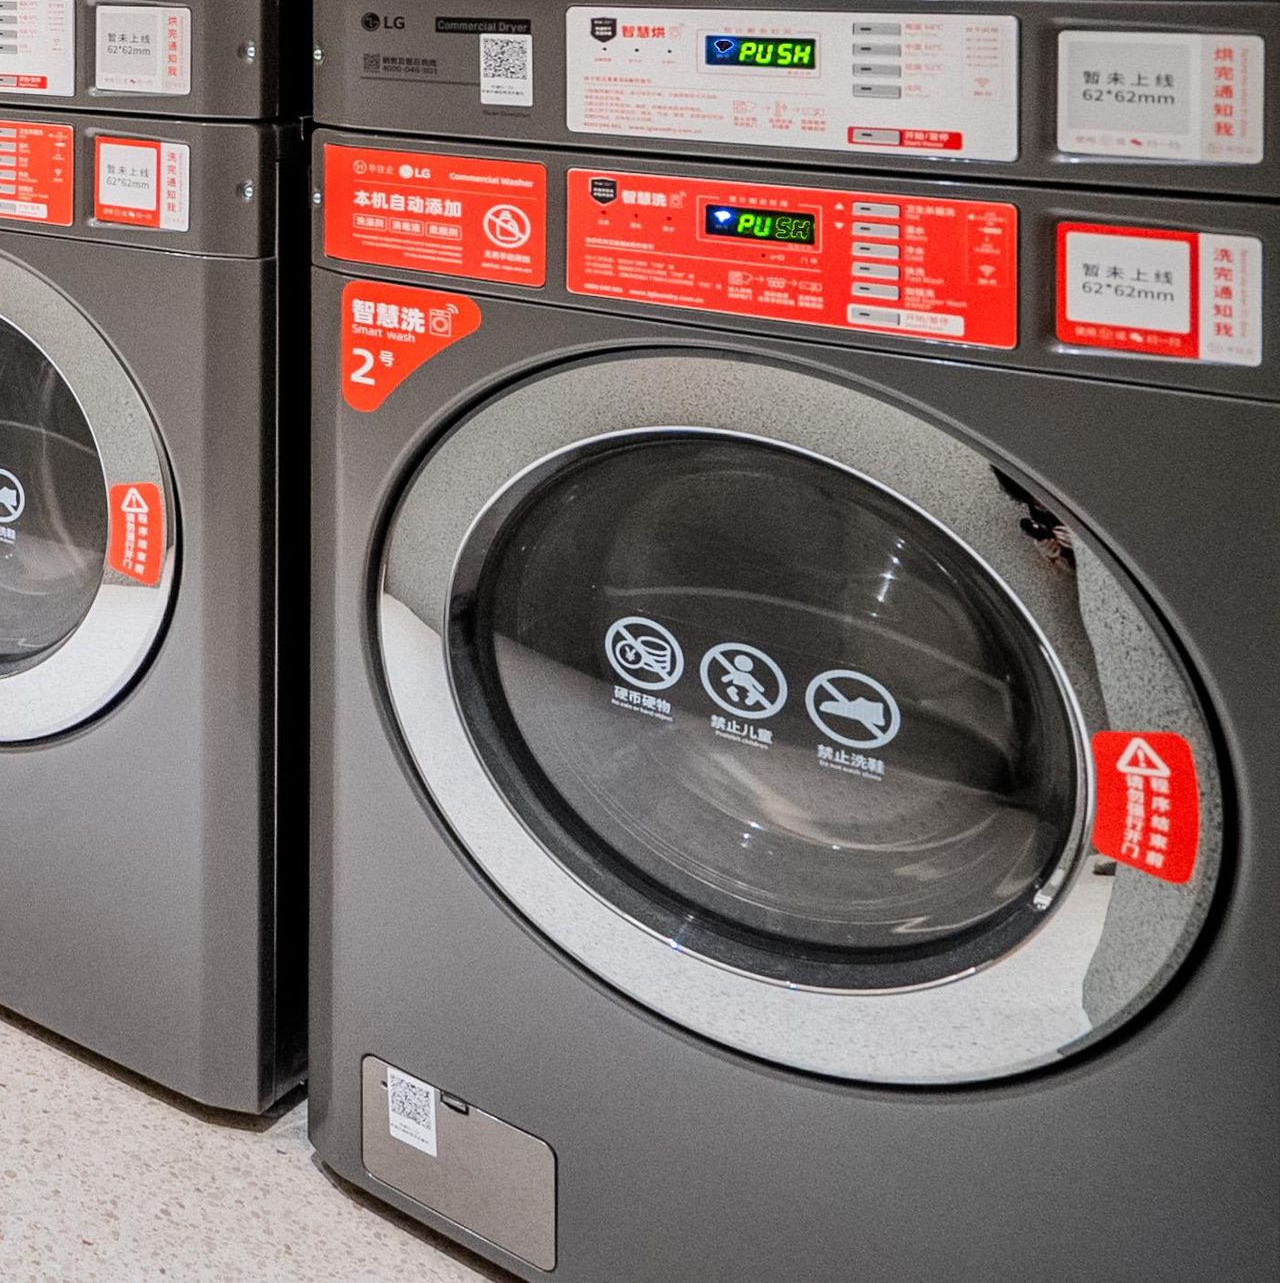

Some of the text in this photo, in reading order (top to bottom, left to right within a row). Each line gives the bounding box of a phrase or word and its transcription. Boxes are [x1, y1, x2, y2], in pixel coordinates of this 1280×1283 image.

[383, 16, 406, 29] LG
[437, 19, 528, 34] Commercial Dryer
[621, 25, 666, 39] 智慧烘
[107, 32, 151, 44] 暂未上线
[739, 41, 812, 65] PUSH
[1083, 70, 1175, 88] 暂未上线
[106, 164, 150, 178] 暂未上线
[415, 168, 431, 179] LG
[449, 172, 500, 185] Commercial
[353, 189, 462, 218] 本机自动添加
[621, 189, 668, 208] 智慧洗
[737, 212, 811, 240] PUSH
[1082, 263, 1174, 285] 暂未上线
[352, 298, 426, 334] 智慧洗
[352, 324, 416, 343] Smart wash
[613, 685, 671, 714] 硬币硬物
[710, 714, 773, 745] 禁止儿童
[817, 744, 885, 775] 禁止洗鞋
